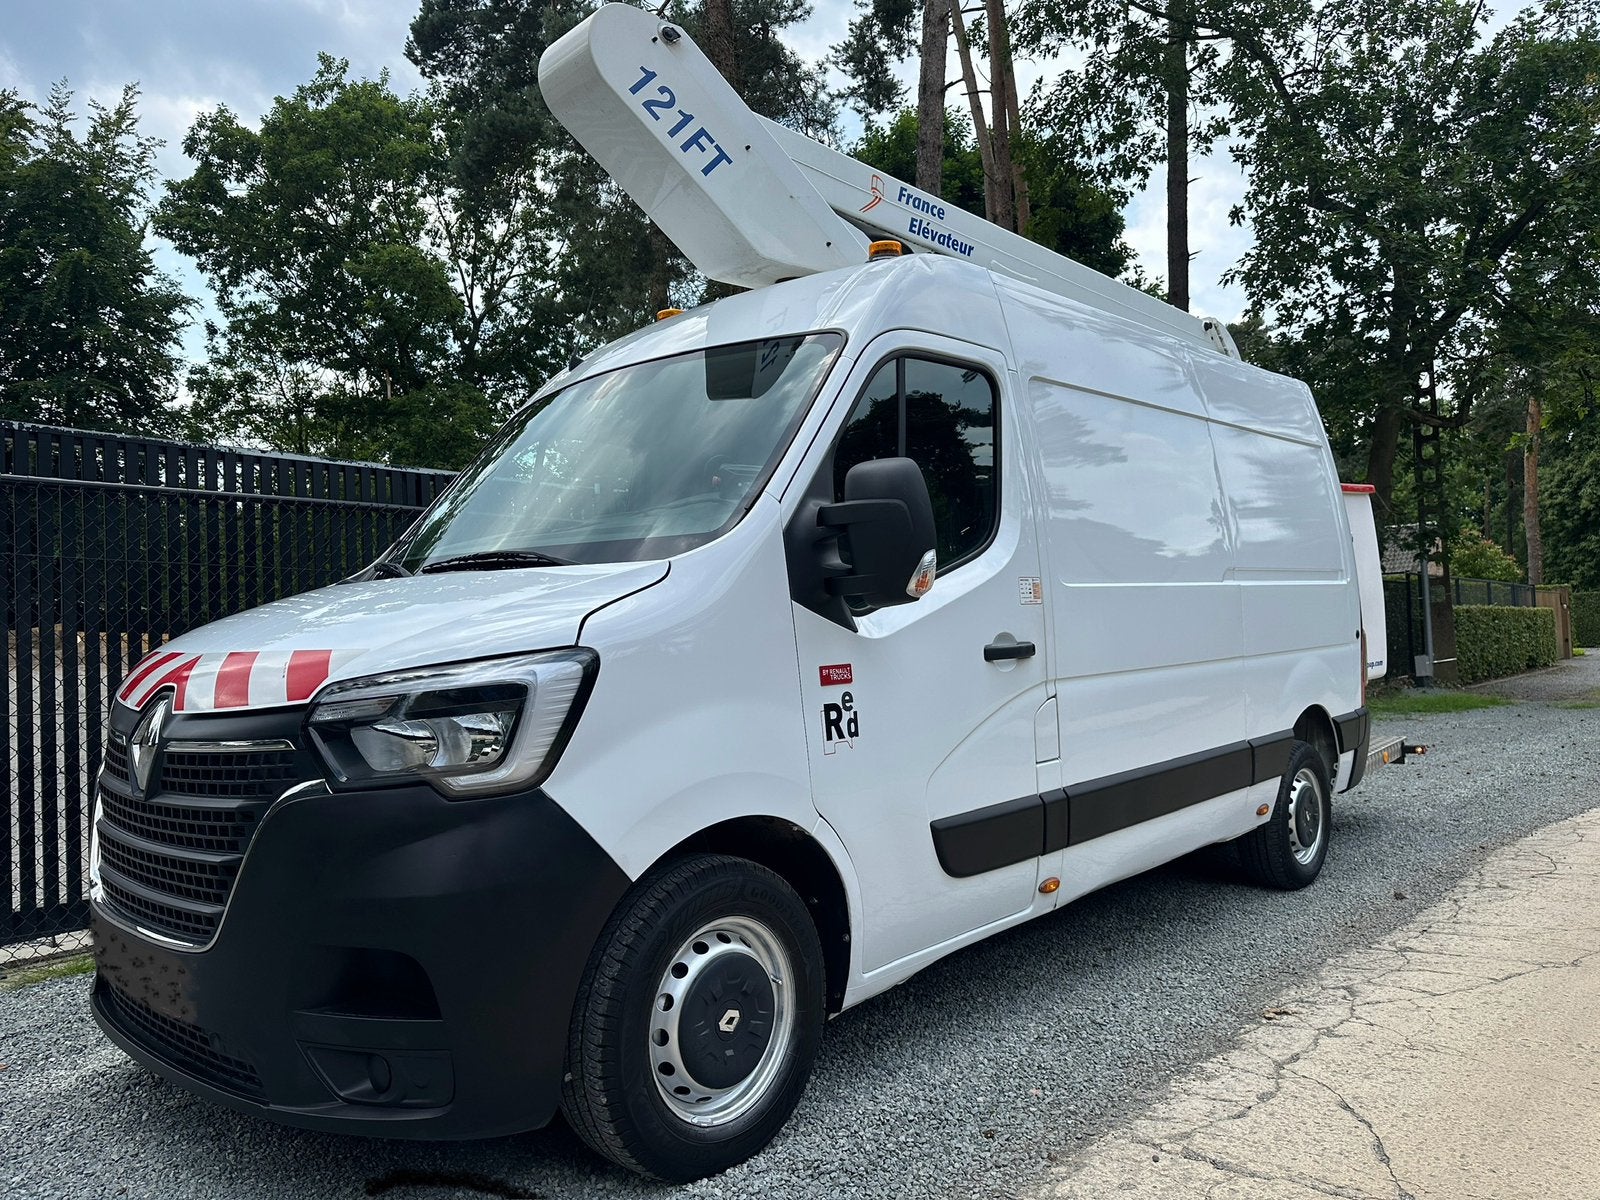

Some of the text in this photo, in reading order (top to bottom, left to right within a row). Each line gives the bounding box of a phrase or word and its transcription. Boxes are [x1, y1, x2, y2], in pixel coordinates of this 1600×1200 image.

[628, 65, 733, 177] 121FT
[897, 186, 945, 220] France
[908, 217, 975, 257] Elévateur
[830, 667, 850, 675] RENAULT
[830, 673, 851, 681] TRUCKS
